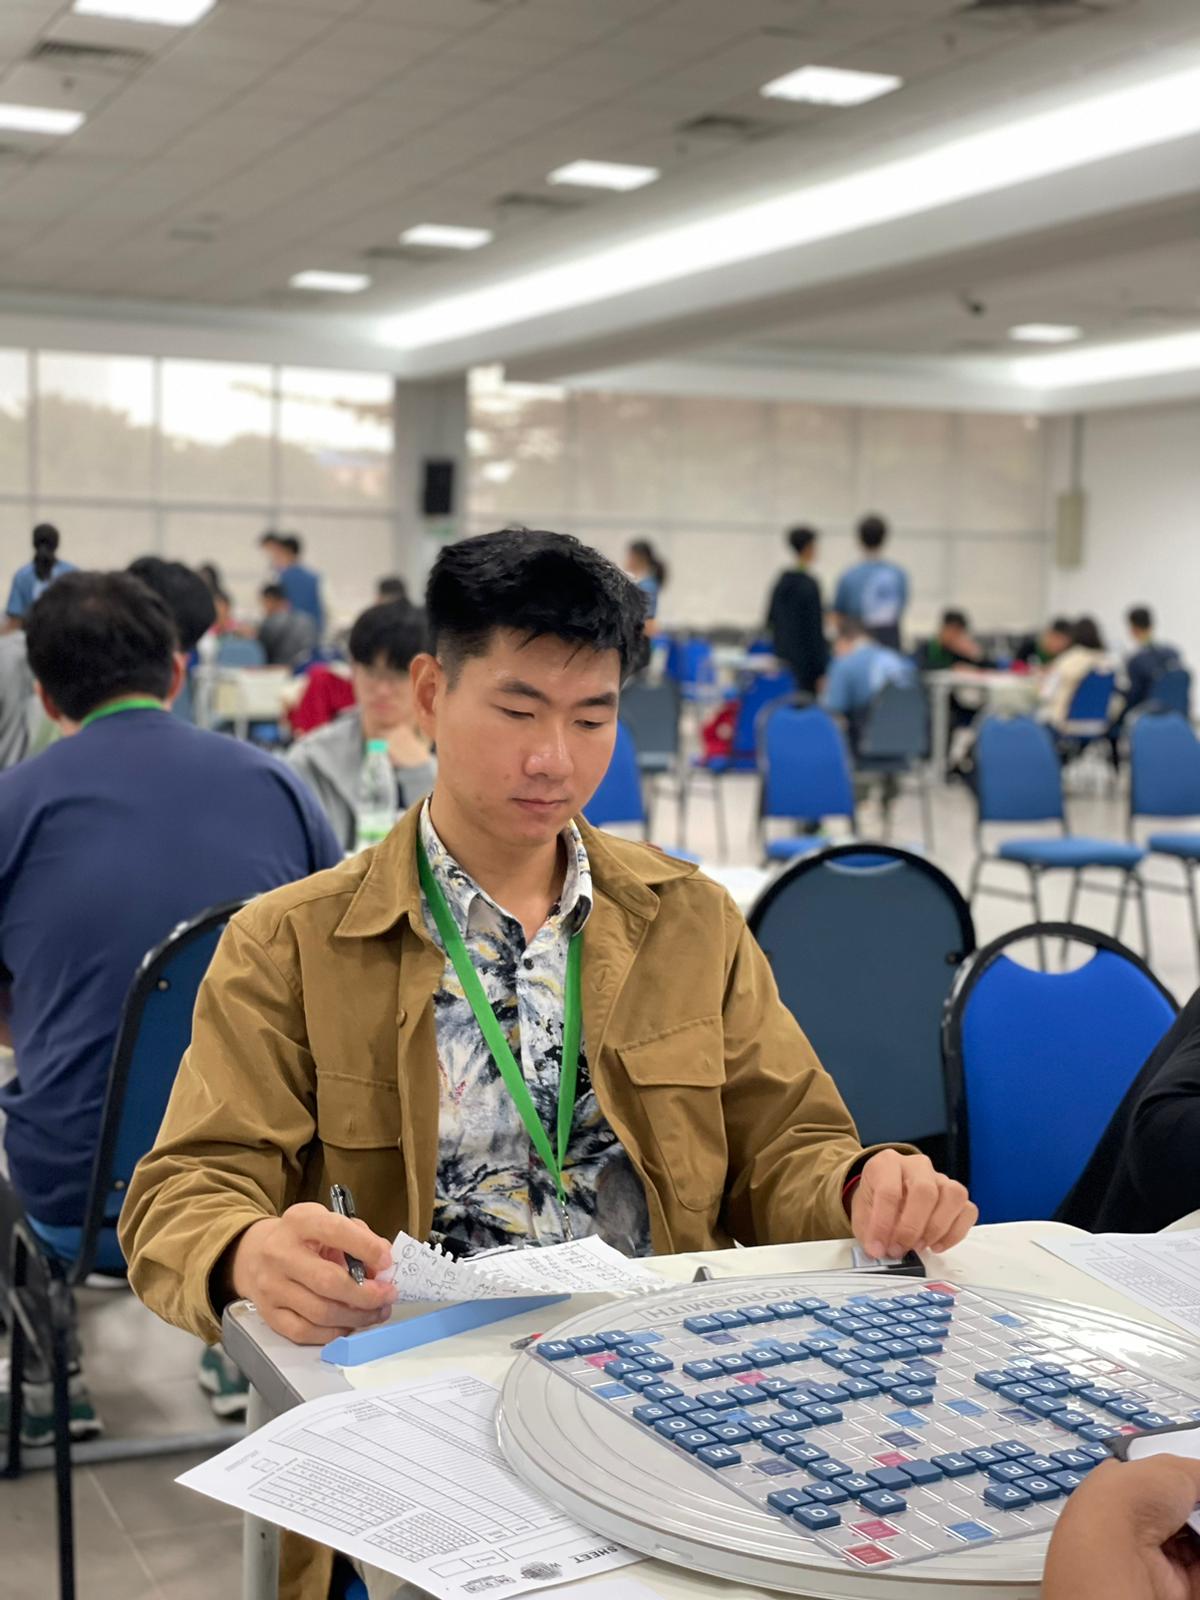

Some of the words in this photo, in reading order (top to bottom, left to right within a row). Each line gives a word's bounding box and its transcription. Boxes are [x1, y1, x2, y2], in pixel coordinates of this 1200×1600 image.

[650, 1286, 805, 1319] WORDSMITH
[695, 1299, 822, 1326] SWELL
[548, 1333, 626, 1352] TUN
